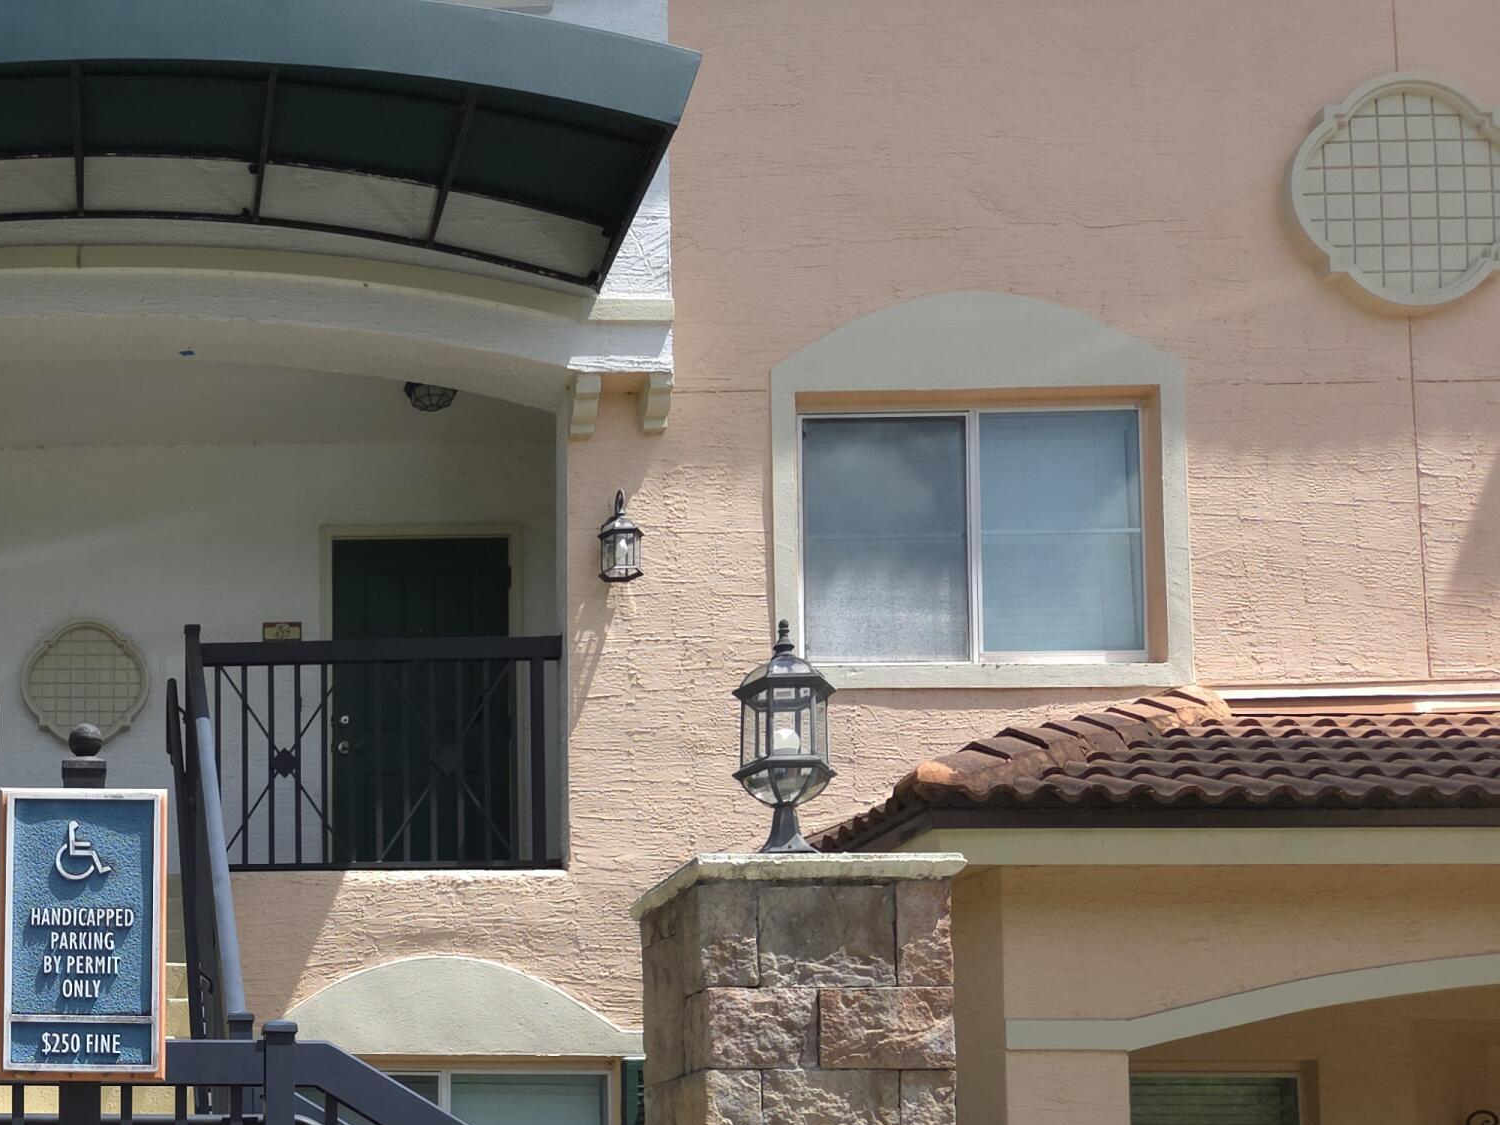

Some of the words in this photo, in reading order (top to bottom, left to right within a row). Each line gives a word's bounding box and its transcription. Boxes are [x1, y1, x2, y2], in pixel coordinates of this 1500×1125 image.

[31, 907, 134, 927] HANDICAPPED
[51, 931, 115, 950] PARKING
[43, 955, 63, 974] BY
[66, 955, 120, 975] PERMIT
[62, 979, 101, 998] ONLY
[41, 1031, 80, 1054] $250
[86, 1033, 121, 1054] FINE
